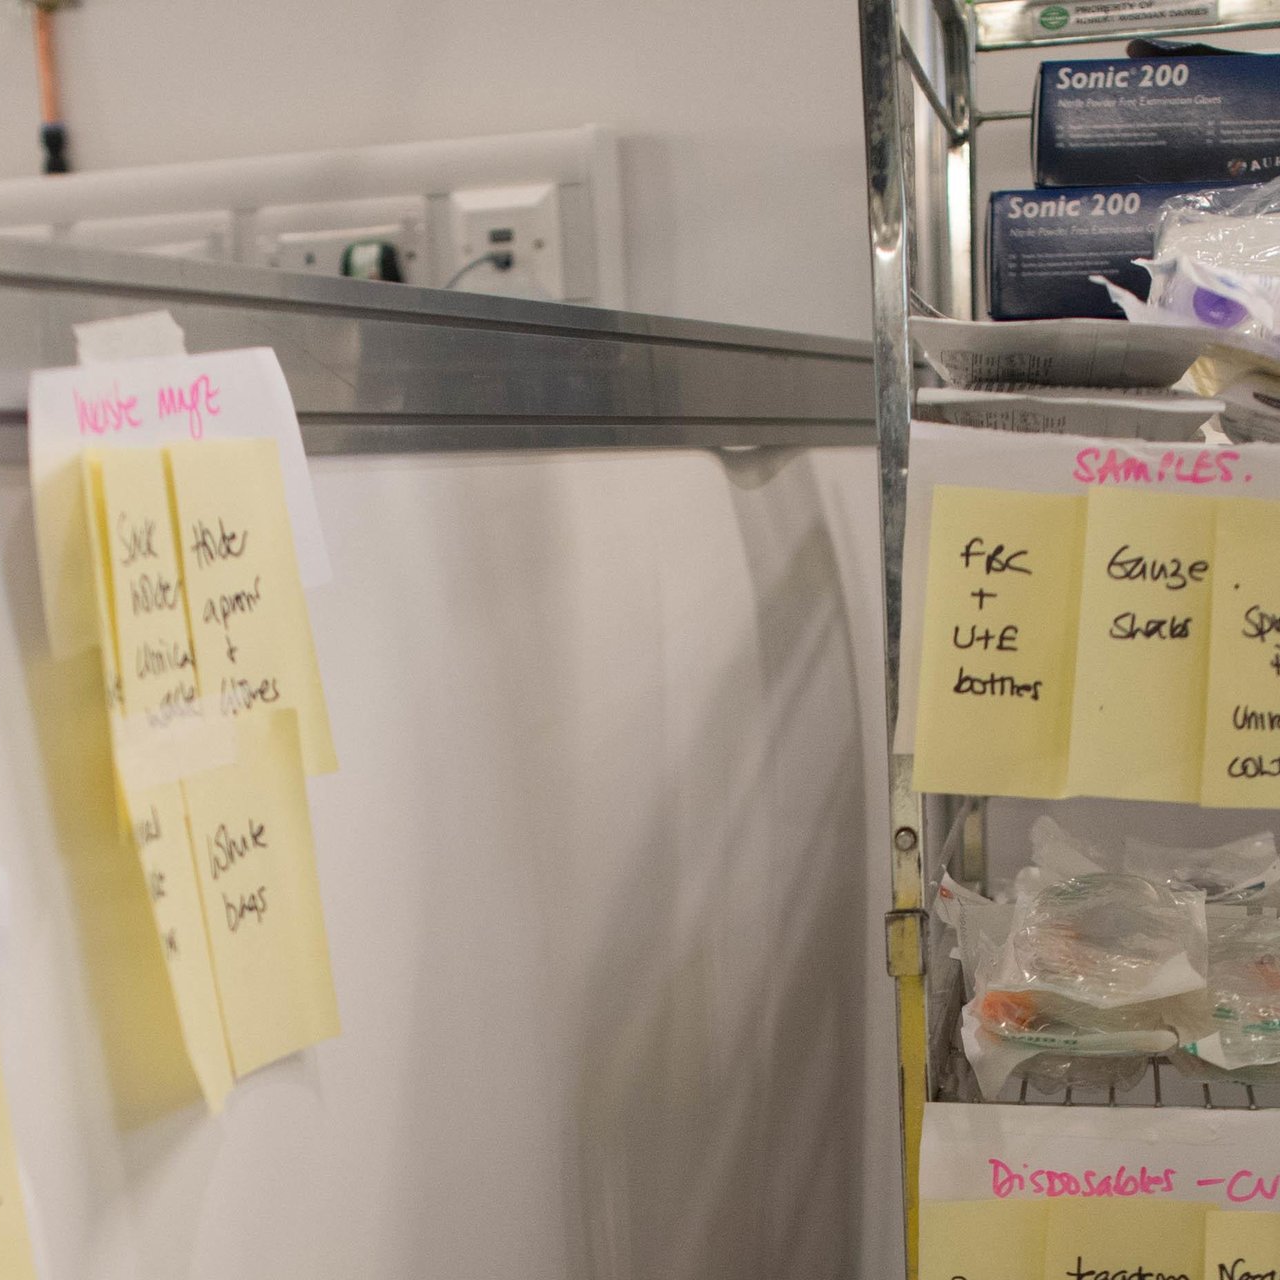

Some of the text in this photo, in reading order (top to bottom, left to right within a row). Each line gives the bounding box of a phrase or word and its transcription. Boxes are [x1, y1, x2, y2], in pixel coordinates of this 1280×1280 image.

[1056, 63, 1190, 90] Sonic 200
[1007, 192, 1142, 219] Sonic 200
[970, 587, 998, 610] +
